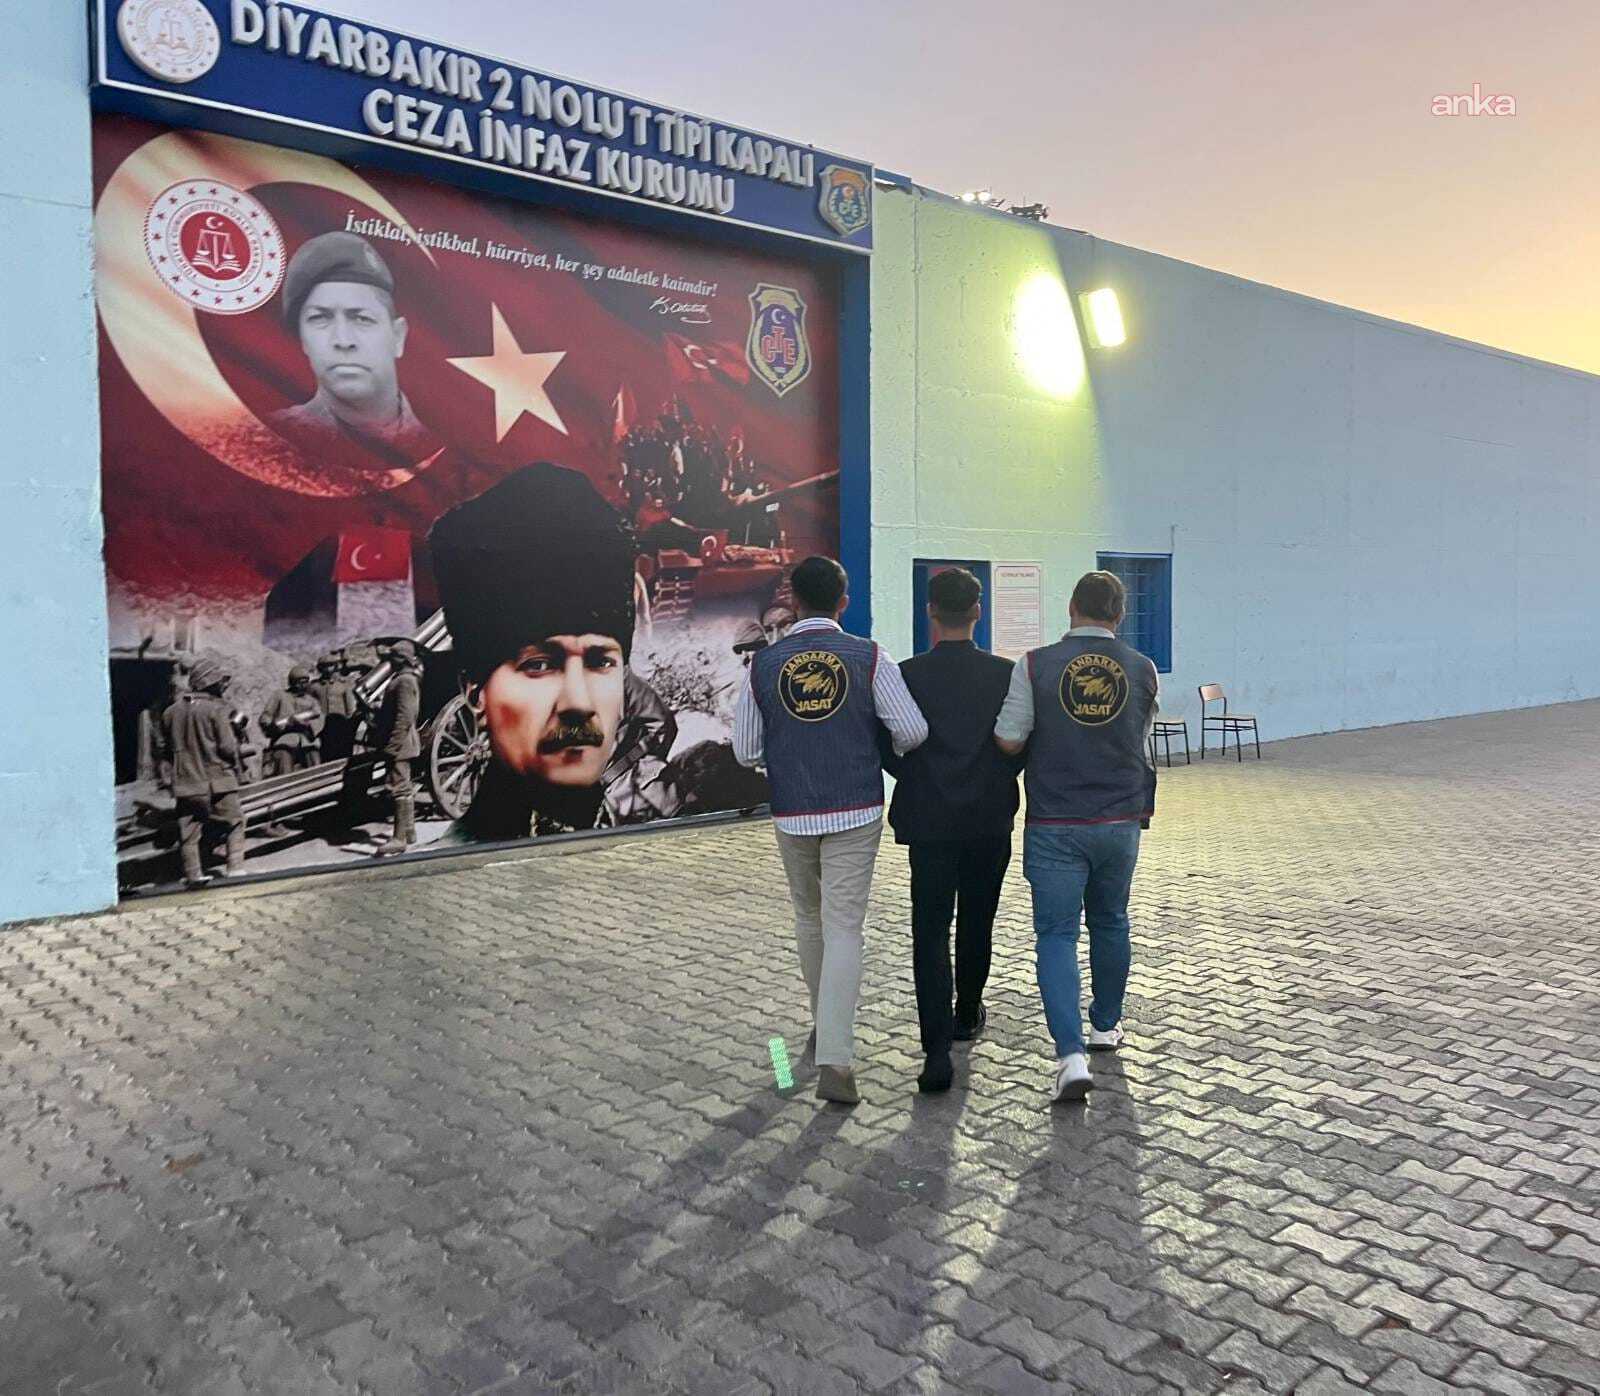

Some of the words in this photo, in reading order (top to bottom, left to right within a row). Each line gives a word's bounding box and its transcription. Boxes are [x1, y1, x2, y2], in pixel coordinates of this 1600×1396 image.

[231, 0, 482, 101] DİYARBAKIR
[488, 67, 515, 112] 2
[520, 74, 624, 139] NOLU
[629, 105, 652, 146] T
[654, 111, 711, 162] TİPİ
[715, 129, 814, 188] KAPALI
[362, 88, 473, 154] CEZA
[479, 108, 592, 181] İNFAZ
[596, 146, 735, 214] KURUMU
[345, 209, 411, 246] İstiklal,
[416, 227, 481, 258] istikbal,
[485, 240, 551, 271] hürriyet,
[555, 253, 580, 272] her
[582, 263, 603, 280] şey
[607, 265, 659, 287] adaletle
[661, 273, 718, 297] kaimdir!
[784, 653, 841, 676] JANDARMA
[1067, 656, 1122, 680] JANDARMA
[795, 698, 833, 713] JASAT
[1074, 704, 1112, 716] JASAT
